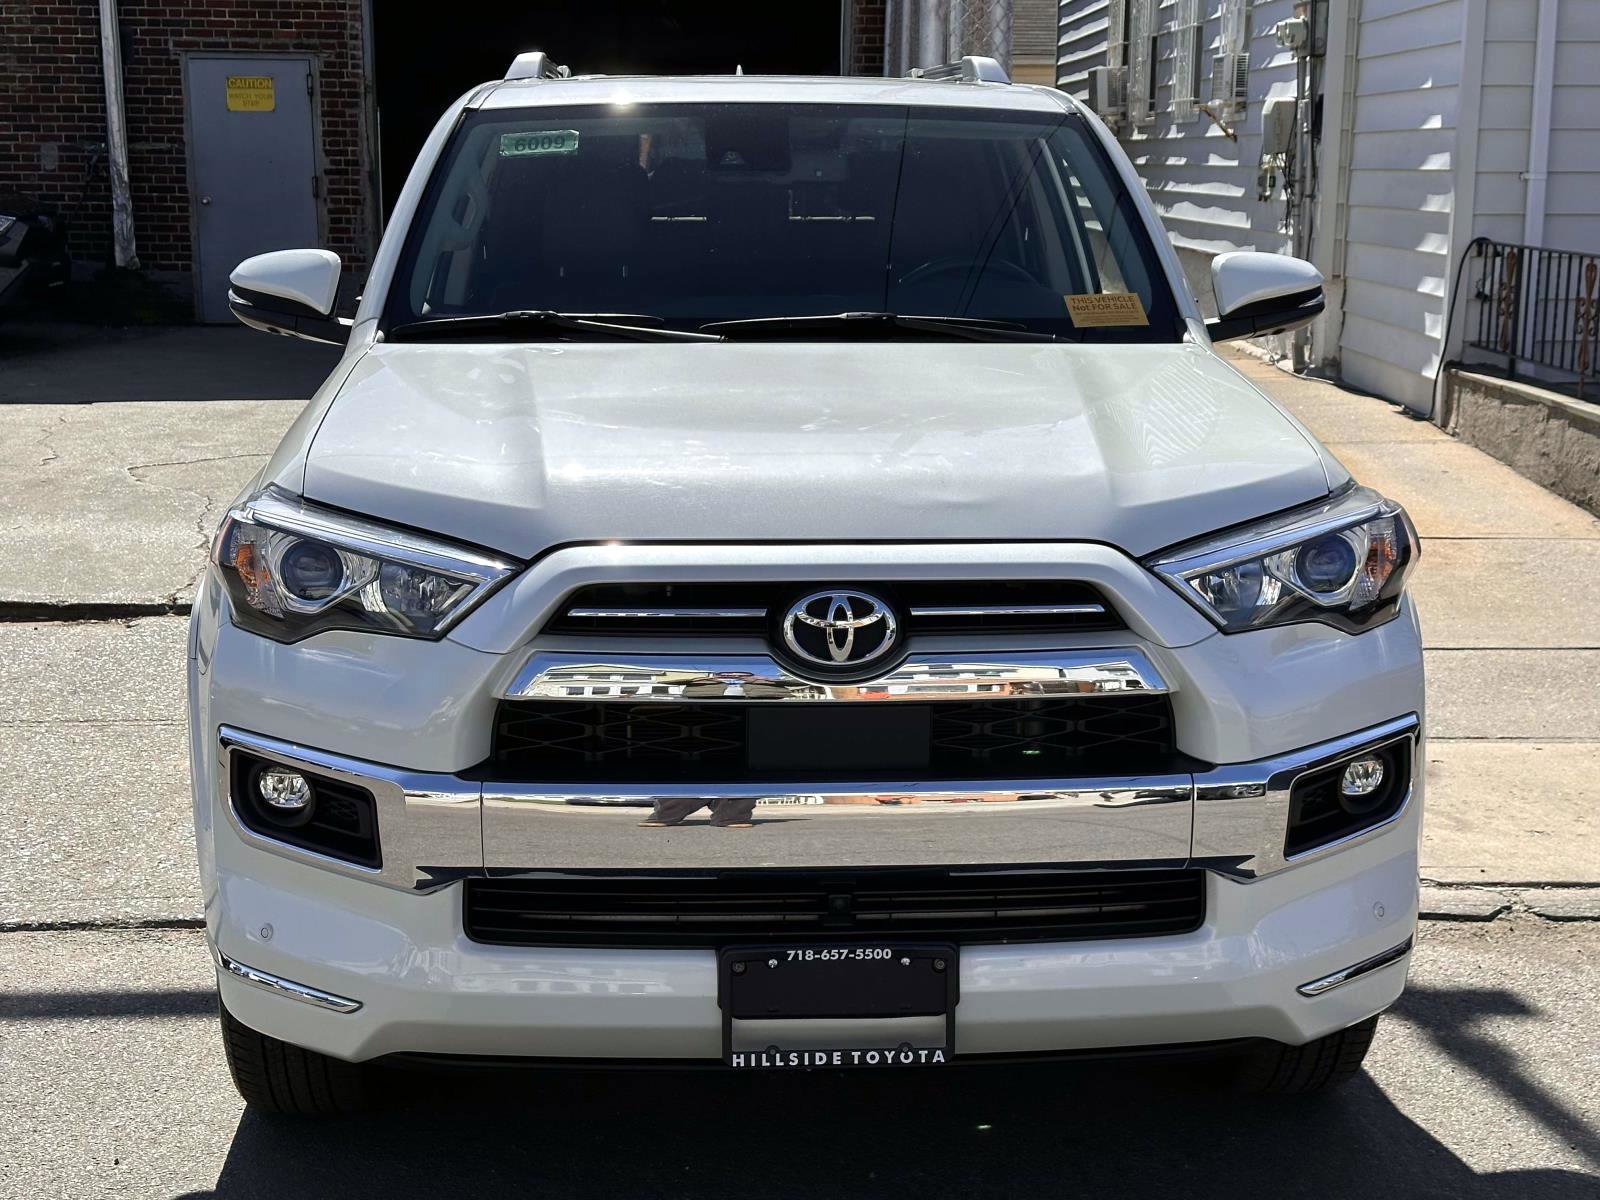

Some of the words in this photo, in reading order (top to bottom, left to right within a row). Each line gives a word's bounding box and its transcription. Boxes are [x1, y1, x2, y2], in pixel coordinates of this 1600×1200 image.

[228, 78, 273, 89] CAUTION
[515, 136, 565, 152] 6009
[1071, 297, 1094, 305] THIS
[1095, 295, 1136, 304] VEHICLE
[1092, 303, 1113, 311] FOR
[1113, 302, 1137, 310] SALE
[787, 948, 893, 961] 718-657-5500
[732, 1051, 842, 1068] HILLSIDE
[851, 1049, 946, 1065] TOYOTA
